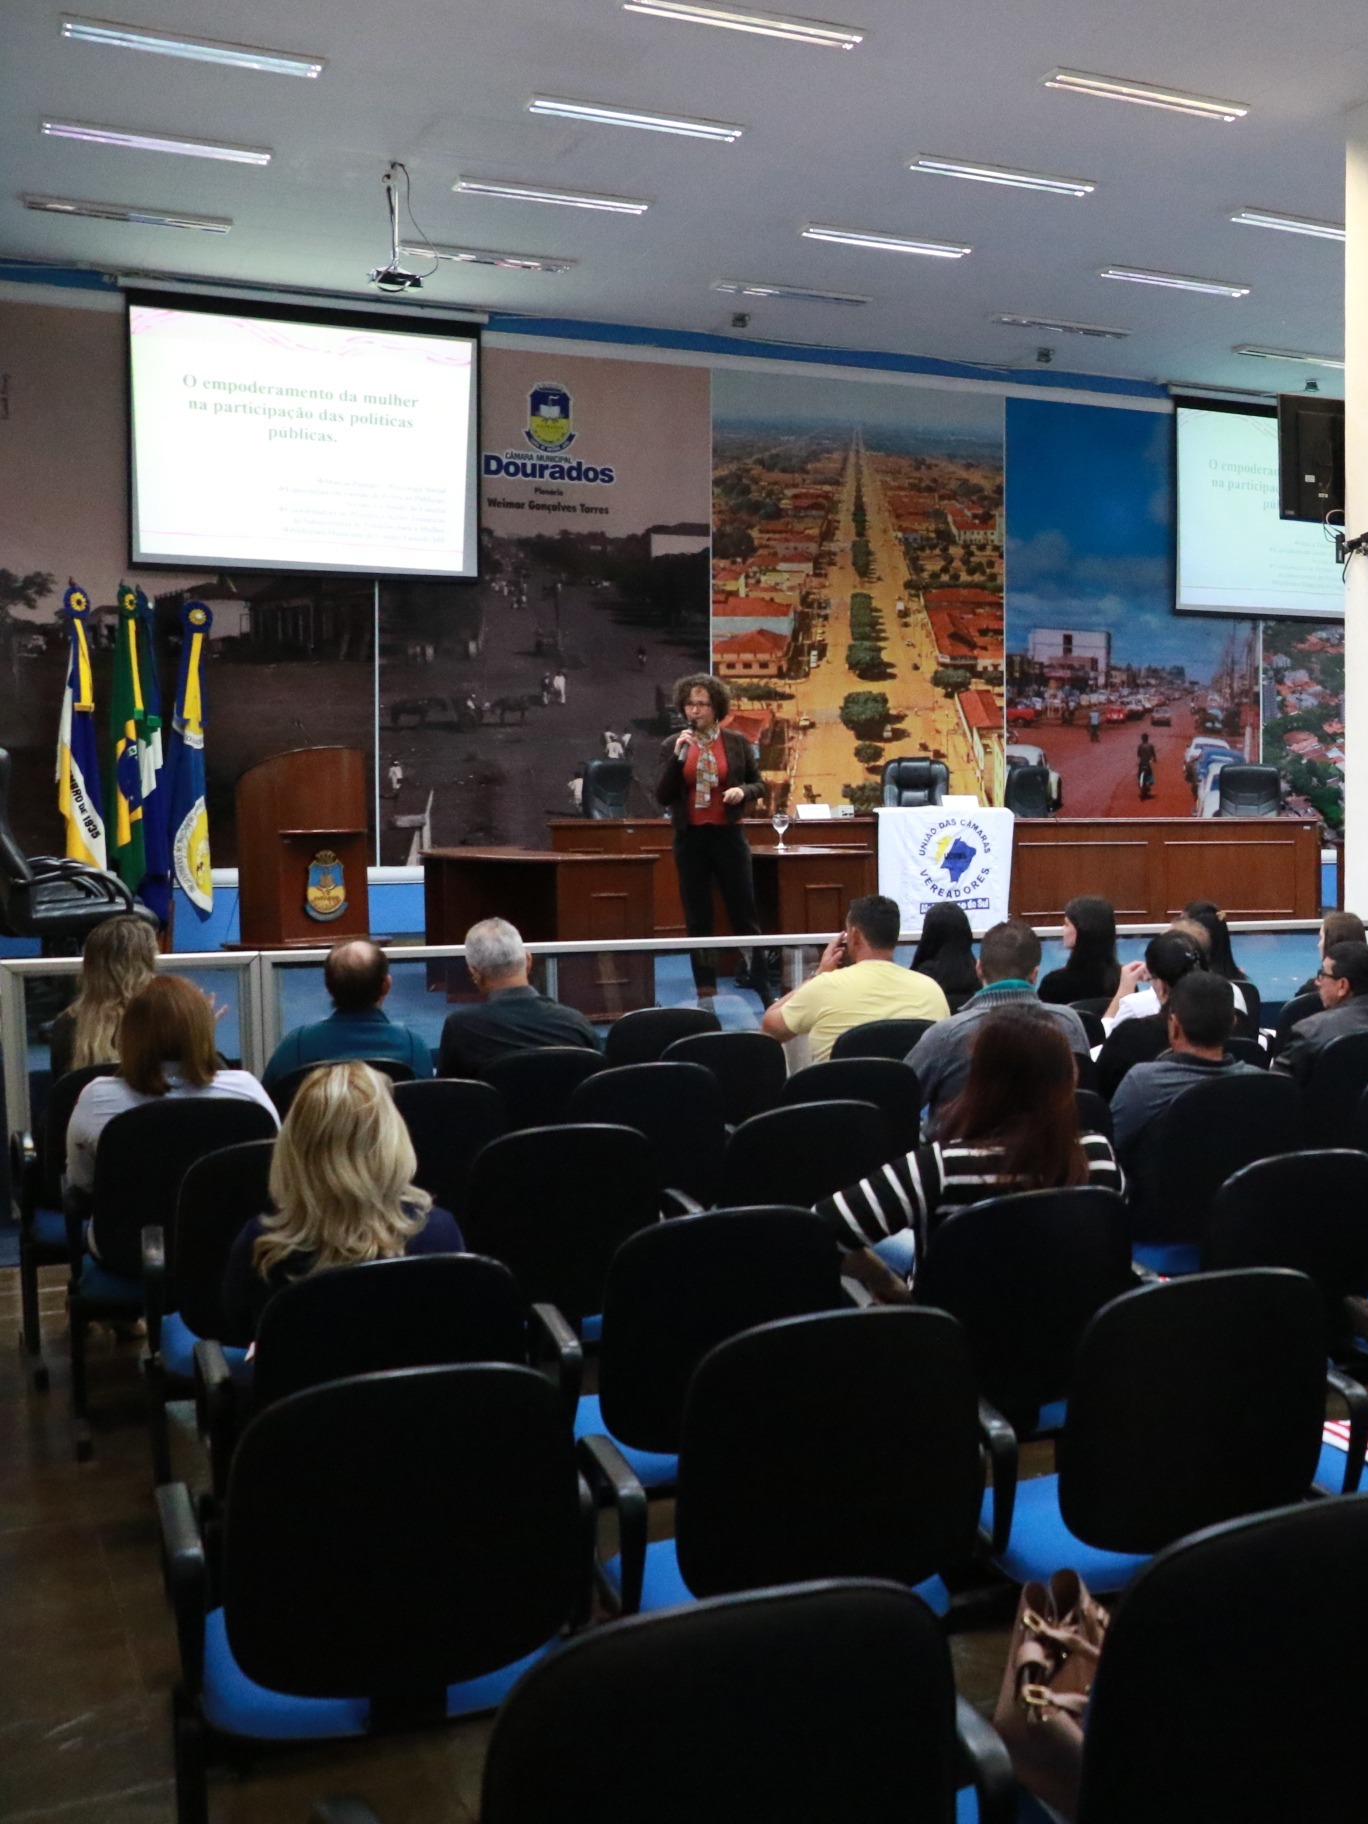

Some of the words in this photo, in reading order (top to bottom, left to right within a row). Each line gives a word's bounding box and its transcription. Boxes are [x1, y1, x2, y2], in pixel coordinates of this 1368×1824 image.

[182, 373, 198, 388] O
[202, 378, 334, 402] empoderamento
[339, 389, 358, 404] da
[363, 391, 419, 409] mulher
[188, 398, 208, 412] na
[213, 400, 314, 422] participação
[318, 408, 345, 424] das
[483, 453, 615, 484] Dourados
[536, 454, 573, 465] MUNICIPAL
[1208, 458, 1218, 470] O
[1212, 478, 1224, 488] na
[487, 497, 526, 510] Weimar
[528, 500, 577, 515] Gonçalves
[580, 503, 610, 515] Torres
[918, 827, 937, 857] UNIÃO
[938, 818, 957, 829] DAS
[920, 867, 990, 898] VEREADORES
